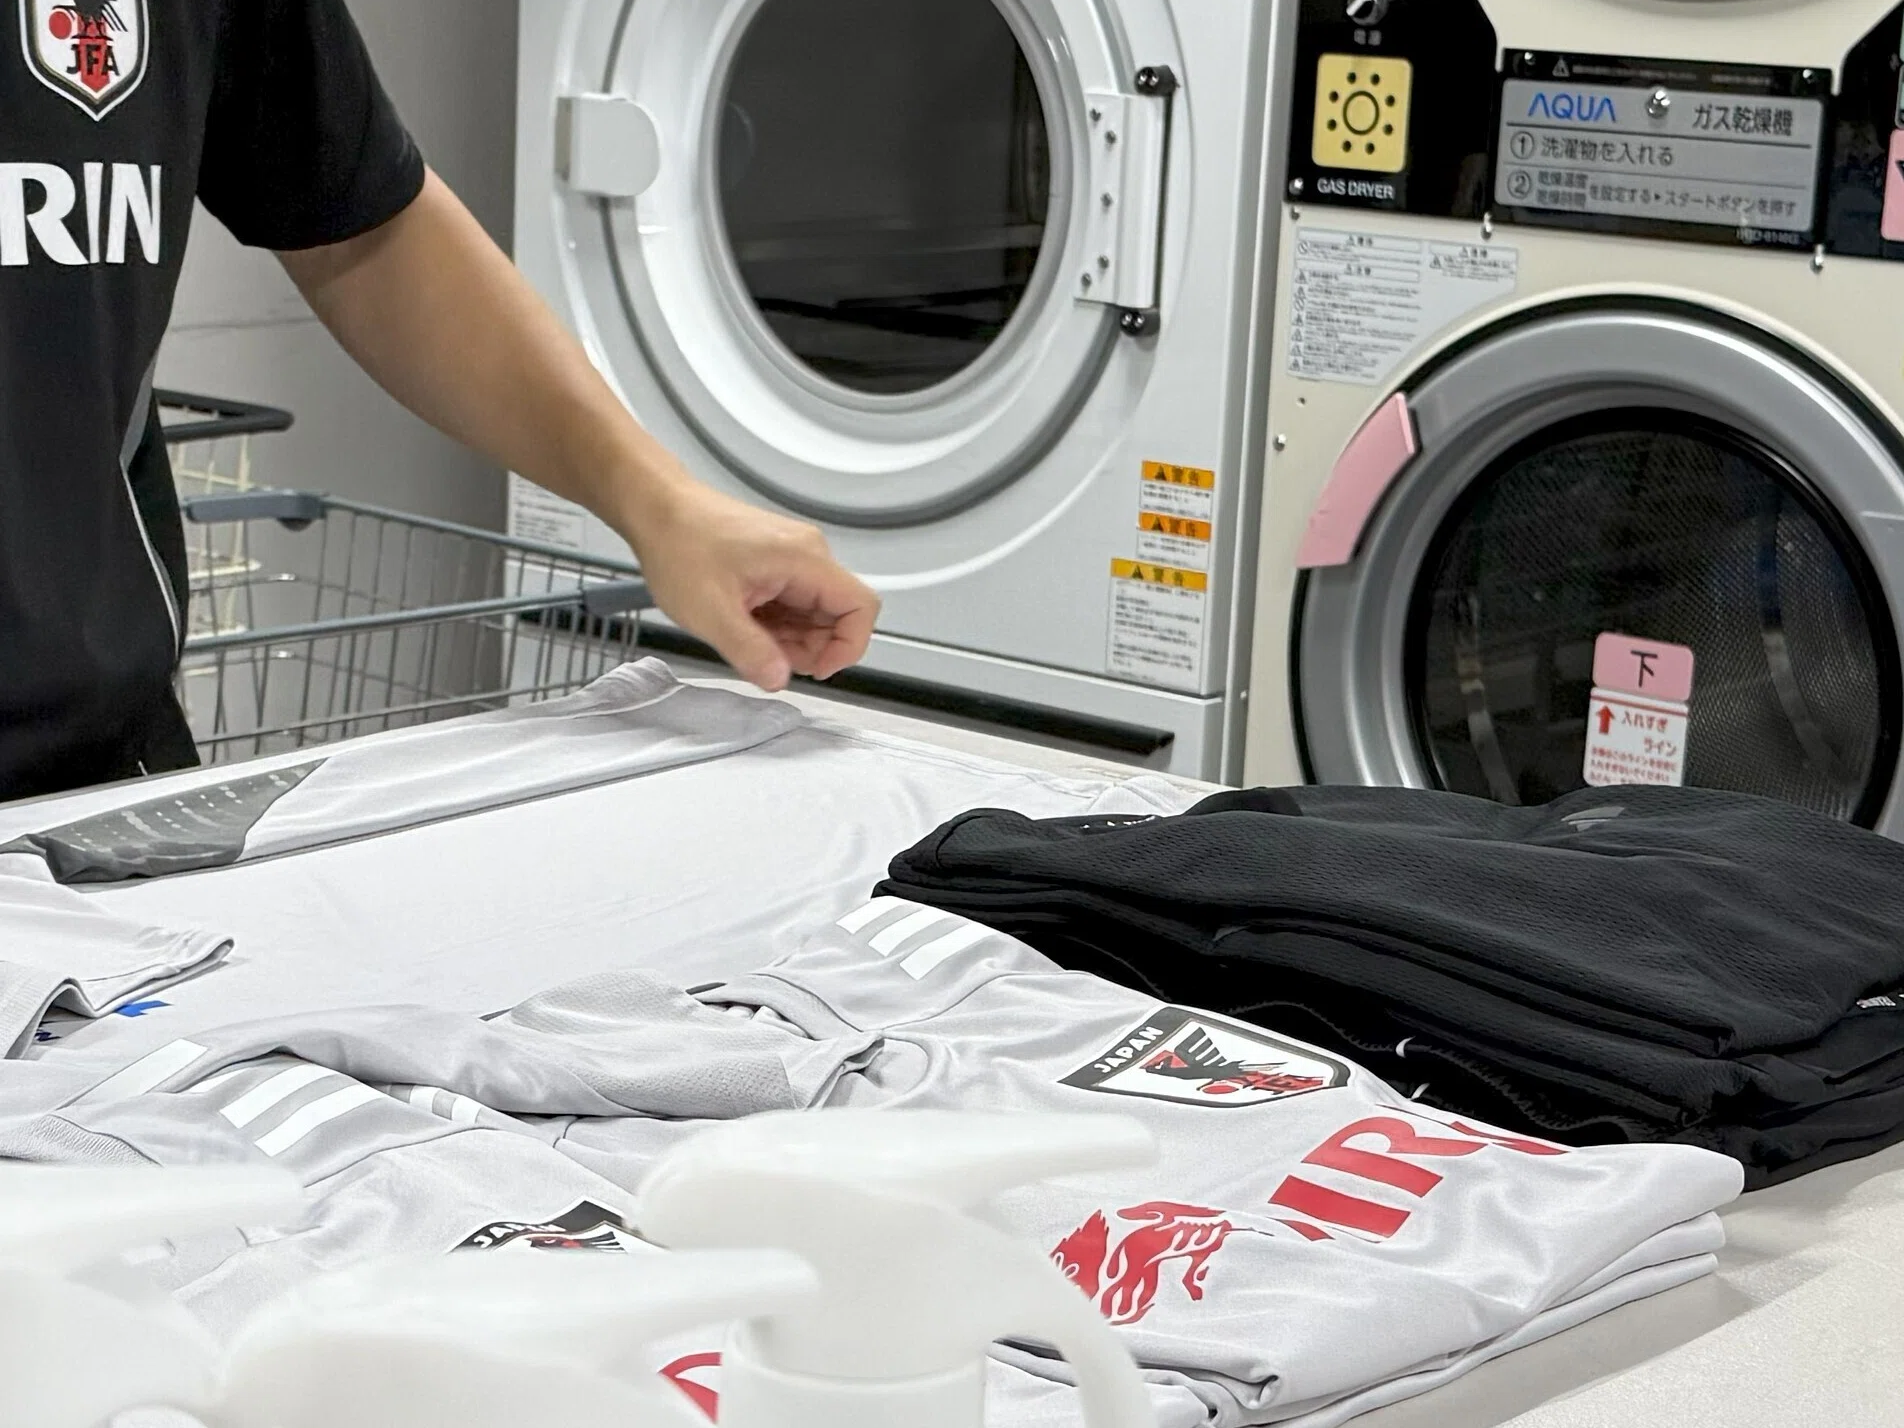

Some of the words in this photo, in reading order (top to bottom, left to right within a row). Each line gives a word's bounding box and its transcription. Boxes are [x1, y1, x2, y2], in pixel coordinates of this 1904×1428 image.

[67, 44, 121, 77] JFA
[1528, 92, 1617, 122] AQUA
[1692, 103, 1793, 137] ガス乾燥機
[1540, 136, 1673, 166] 洗濯物を入れる
[1317, 178, 1346, 196] GAS
[1348, 180, 1395, 199] DRYER
[1630, 650, 1658, 688] 下
[1093, 1026, 1164, 1074] JAPAN
